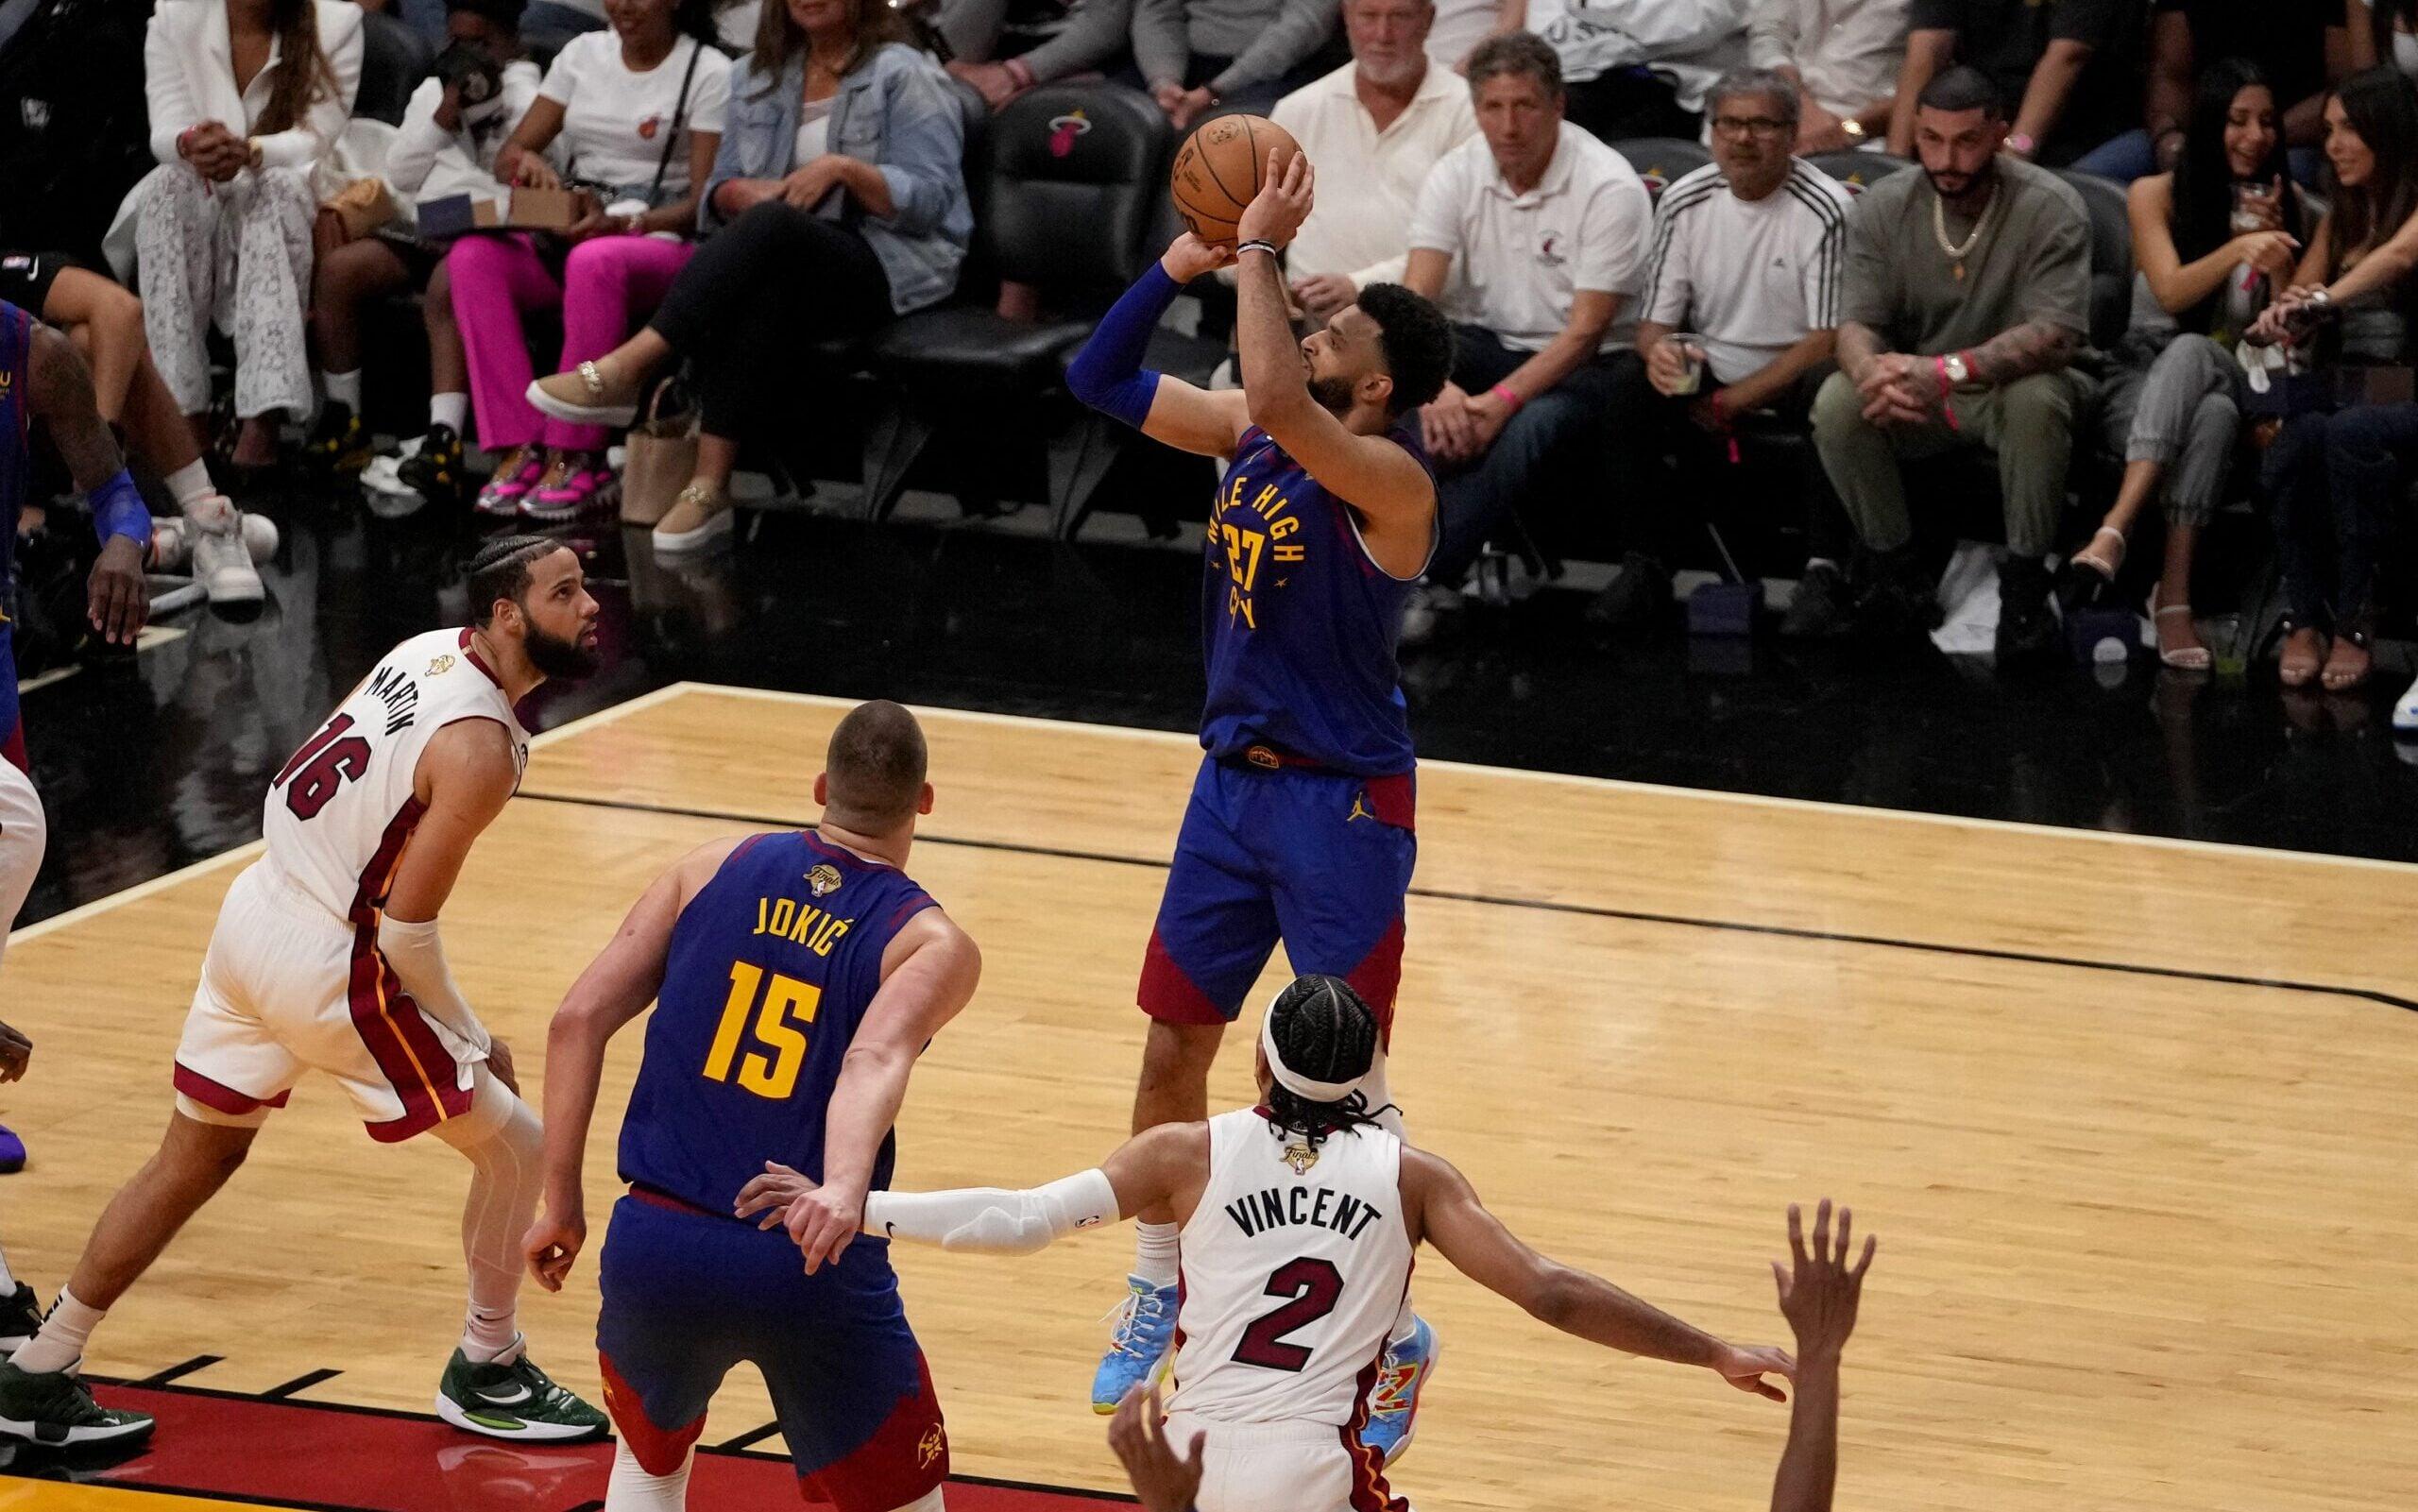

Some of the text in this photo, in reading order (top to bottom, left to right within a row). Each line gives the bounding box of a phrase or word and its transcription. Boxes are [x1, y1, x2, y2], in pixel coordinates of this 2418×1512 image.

[1207, 476, 1304, 562] MILE HIGH
[1221, 523, 1266, 593] 27
[363, 665, 418, 737] MARTIN
[272, 711, 372, 822] 16
[806, 866, 840, 888] Finals
[752, 896, 855, 957] JOKIĆ
[702, 960, 822, 1100] 15
[1283, 1147, 1317, 1161] Finals
[1224, 1185, 1383, 1241] VINCENT
[1230, 1256, 1345, 1372] 2
